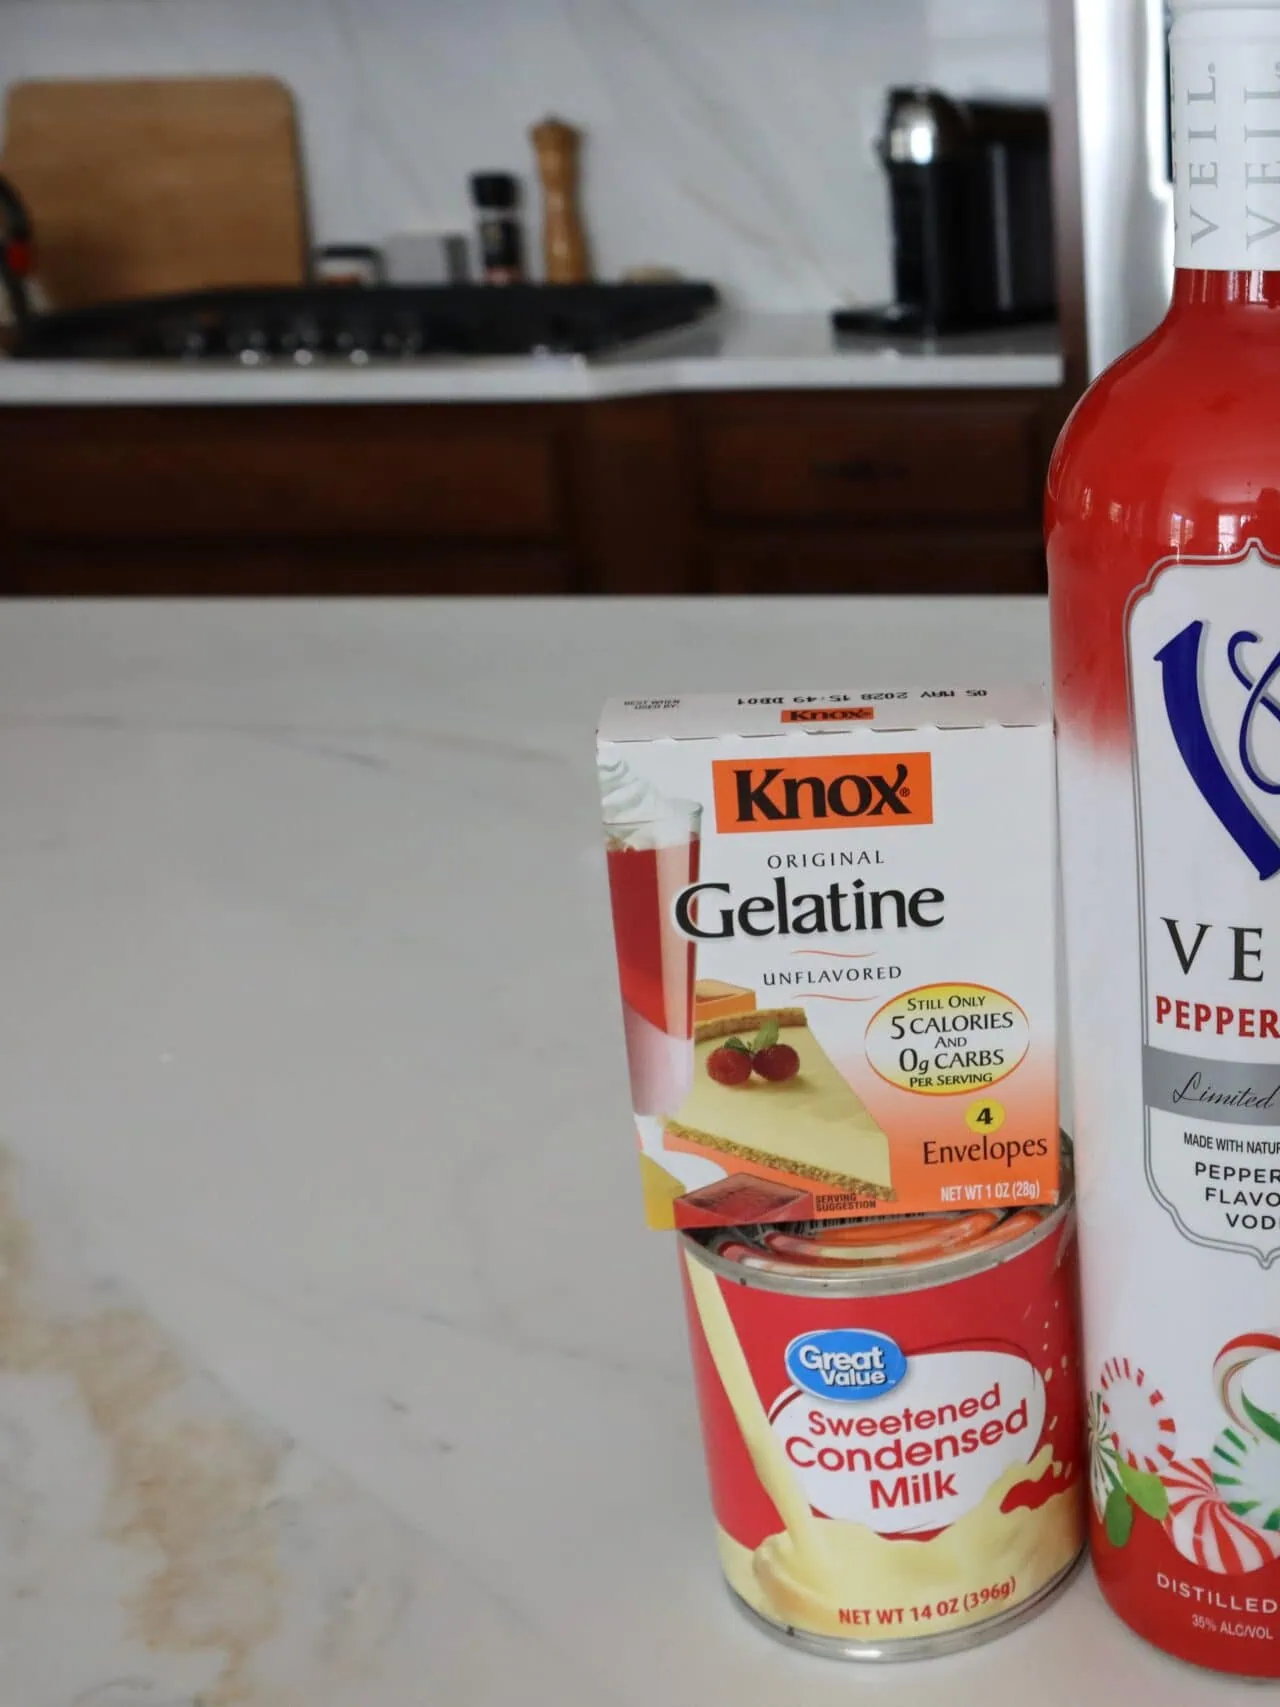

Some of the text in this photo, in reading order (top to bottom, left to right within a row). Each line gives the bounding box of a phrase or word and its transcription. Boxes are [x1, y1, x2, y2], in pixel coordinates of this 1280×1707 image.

[1187, 74, 1220, 250] VEIL
[920, 690, 955, 698] MAY
[734, 763, 912, 822] Knox
[767, 850, 884, 870] ORIGINAL
[675, 876, 944, 938] Gelatine
[763, 966, 902, 986] UNFLAVORED
[907, 995, 986, 1011] STILL ONLY
[890, 1011, 1014, 1040] 5 CALORIES
[934, 1037, 967, 1049] AND
[899, 1048, 1004, 1074] 0g CARBS
[909, 1073, 993, 1088] PER SERVING
[976, 1107, 993, 1125] 4
[923, 1135, 1048, 1168] Envelopes
[1184, 1131, 1213, 1149] MADE
[1216, 1137, 1244, 1153] WITH
[816, 1192, 857, 1202] SERVING
[941, 1180, 1040, 1201] NET WT 1 OZ (28g)
[816, 1200, 876, 1212] SUGGESTION
[799, 1345, 885, 1370] Great
[820, 1367, 886, 1386] Value
[808, 1382, 1001, 1437] Sweetened
[785, 1400, 1029, 1472] Condensed
[870, 1470, 959, 1510] Milk
[838, 1575, 1017, 1626] NET WT 14 OZ (396g)
[1156, 1572, 1278, 1614] DISTILLED
[1191, 1613, 1217, 1632] 35%
[1219, 1621, 1274, 1640] ALC/VOL
